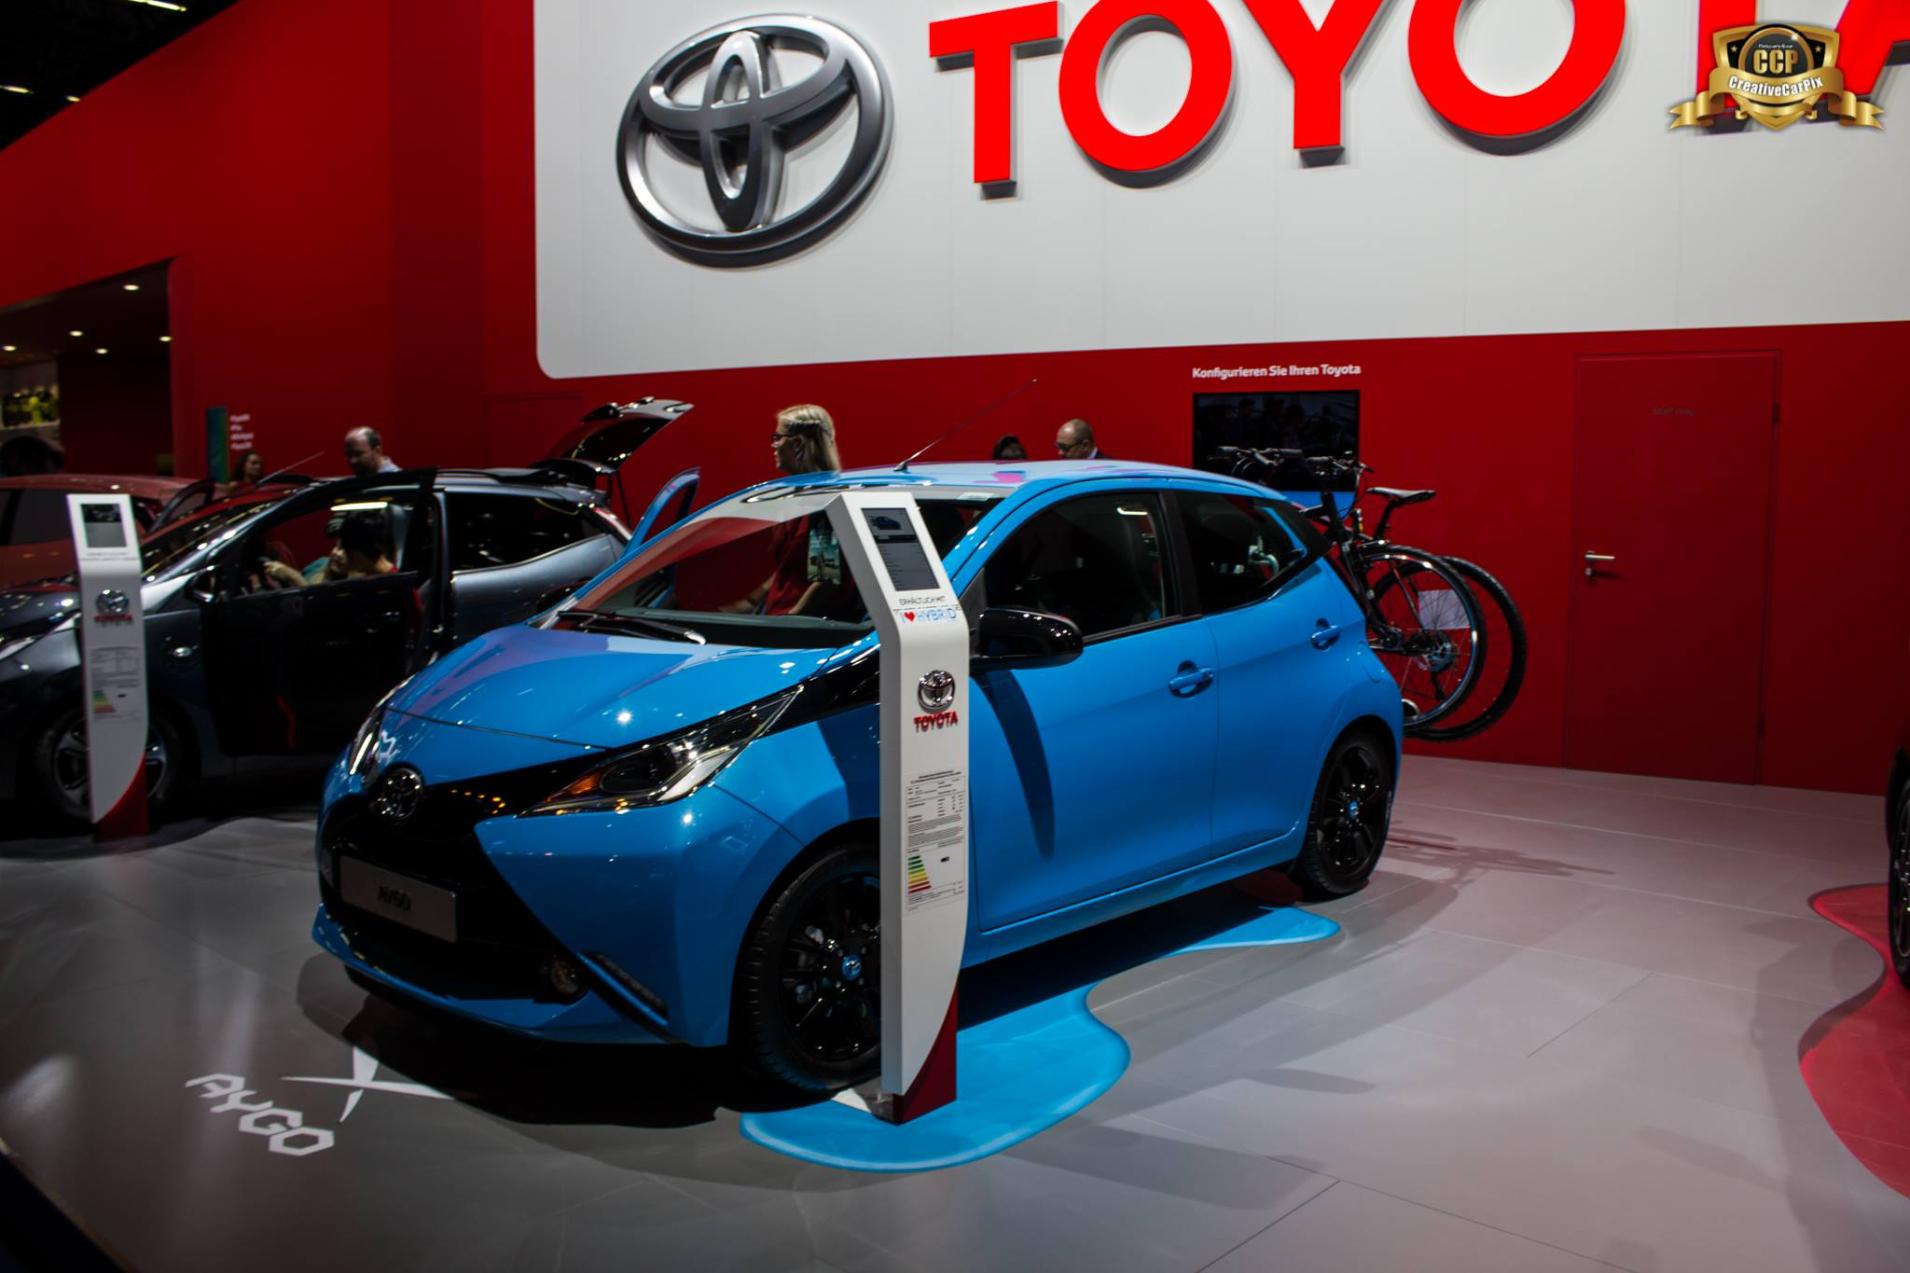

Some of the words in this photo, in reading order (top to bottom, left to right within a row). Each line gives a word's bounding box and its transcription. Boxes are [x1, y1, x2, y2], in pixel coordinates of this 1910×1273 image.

[929, 0, 1910, 192] TOYO
[1192, 366, 1267, 380] Konfigurieren
[1269, 364, 1287, 376] Sie
[1289, 363, 1319, 376] Ihren
[1321, 362, 1361, 377] Toyota
[913, 711, 958, 732] TOYOTA
[184, 1073, 335, 1157] AYGO
